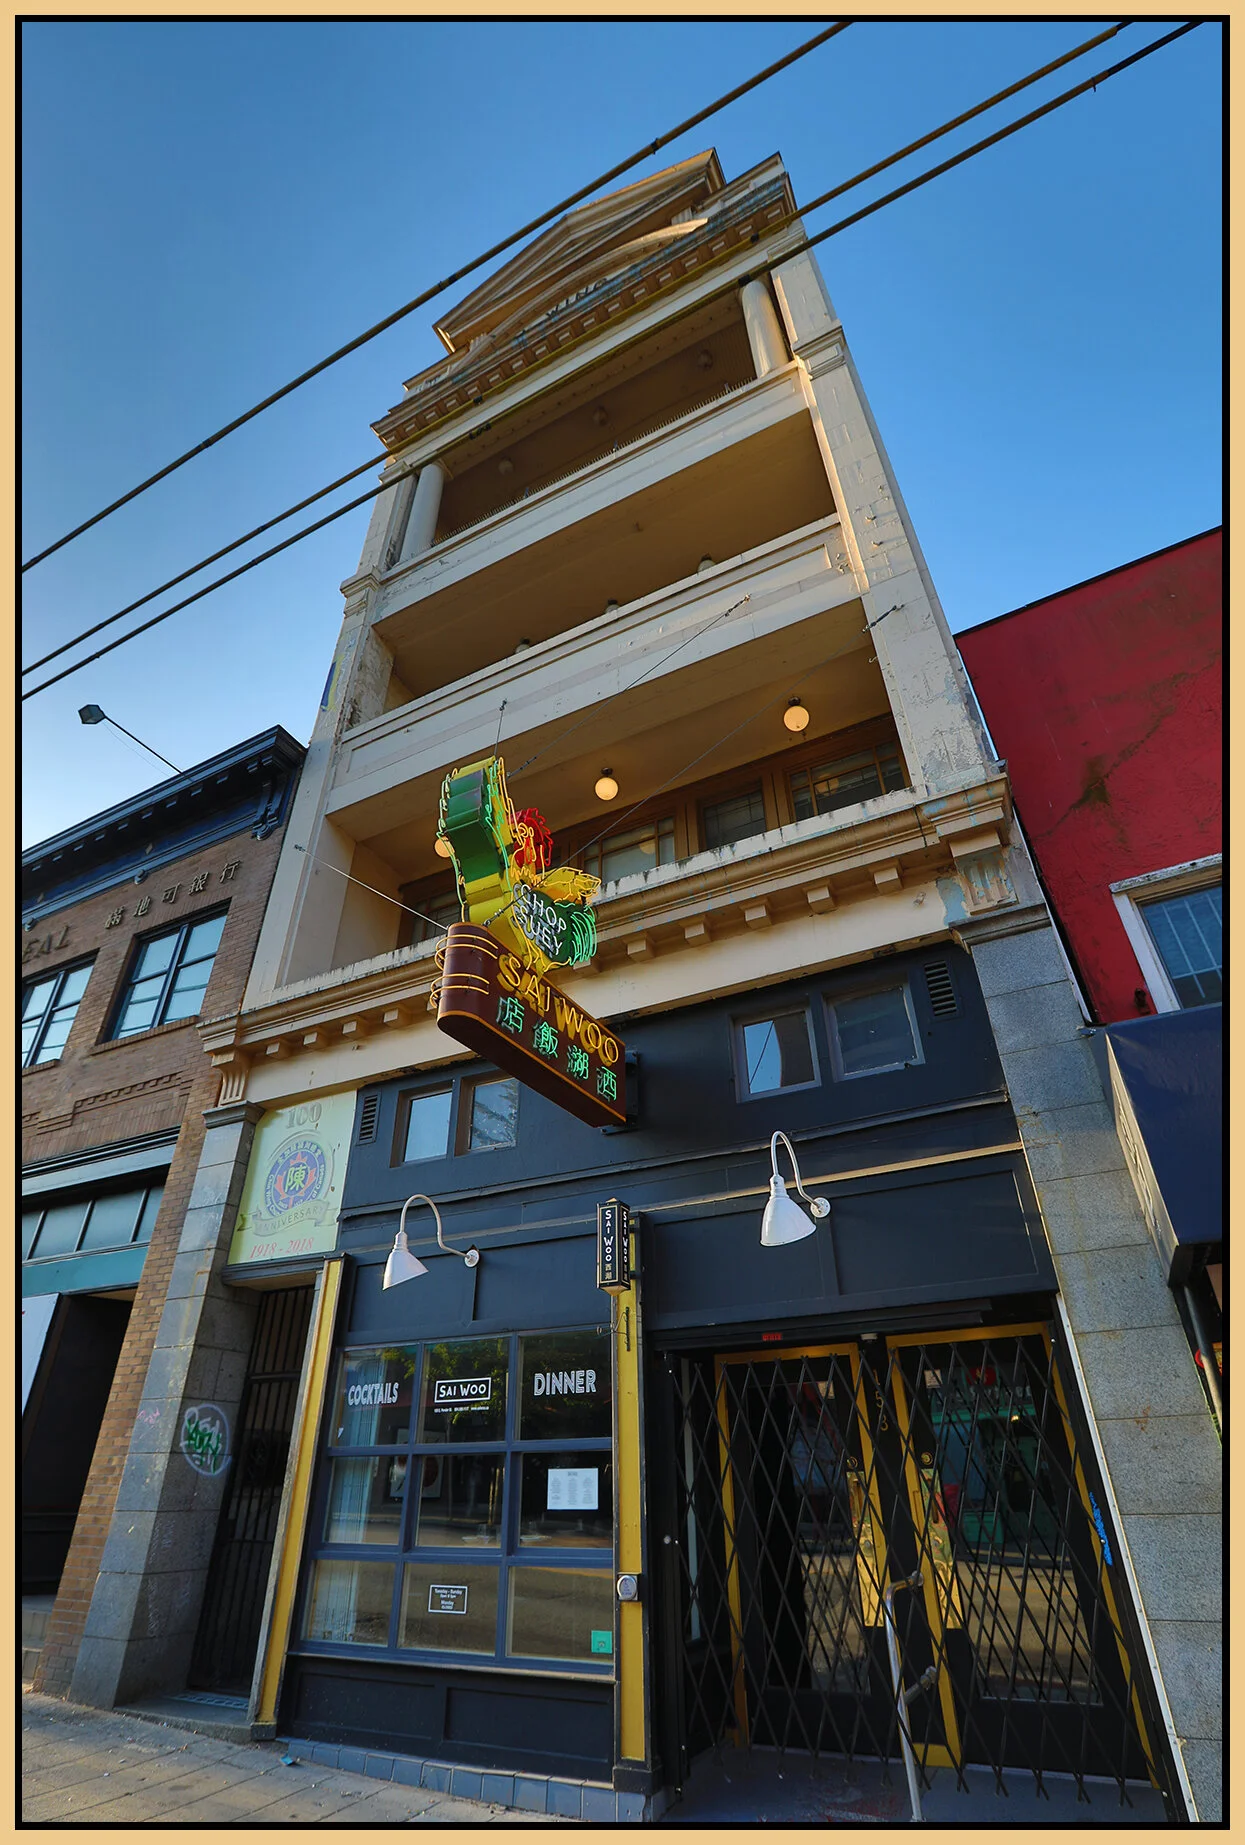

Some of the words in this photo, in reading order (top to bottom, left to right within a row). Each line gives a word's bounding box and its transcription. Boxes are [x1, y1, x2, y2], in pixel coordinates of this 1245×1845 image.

[514, 883, 567, 934] CHOP
[512, 905, 563, 957] SUEY
[497, 953, 551, 1016] SAI
[554, 997, 619, 1066] WOO
[286, 1101, 323, 1129] 100
[285, 1164, 307, 1193] 陳
[248, 1242, 277, 1259] 1918
[285, 1237, 315, 1254] 2018
[603, 1236, 614, 1262] WOO
[348, 1382, 399, 1406] COCKTAILS
[439, 1385, 457, 1398] SAI
[460, 1383, 487, 1397] WOO
[533, 1369, 598, 1397] DINNER
